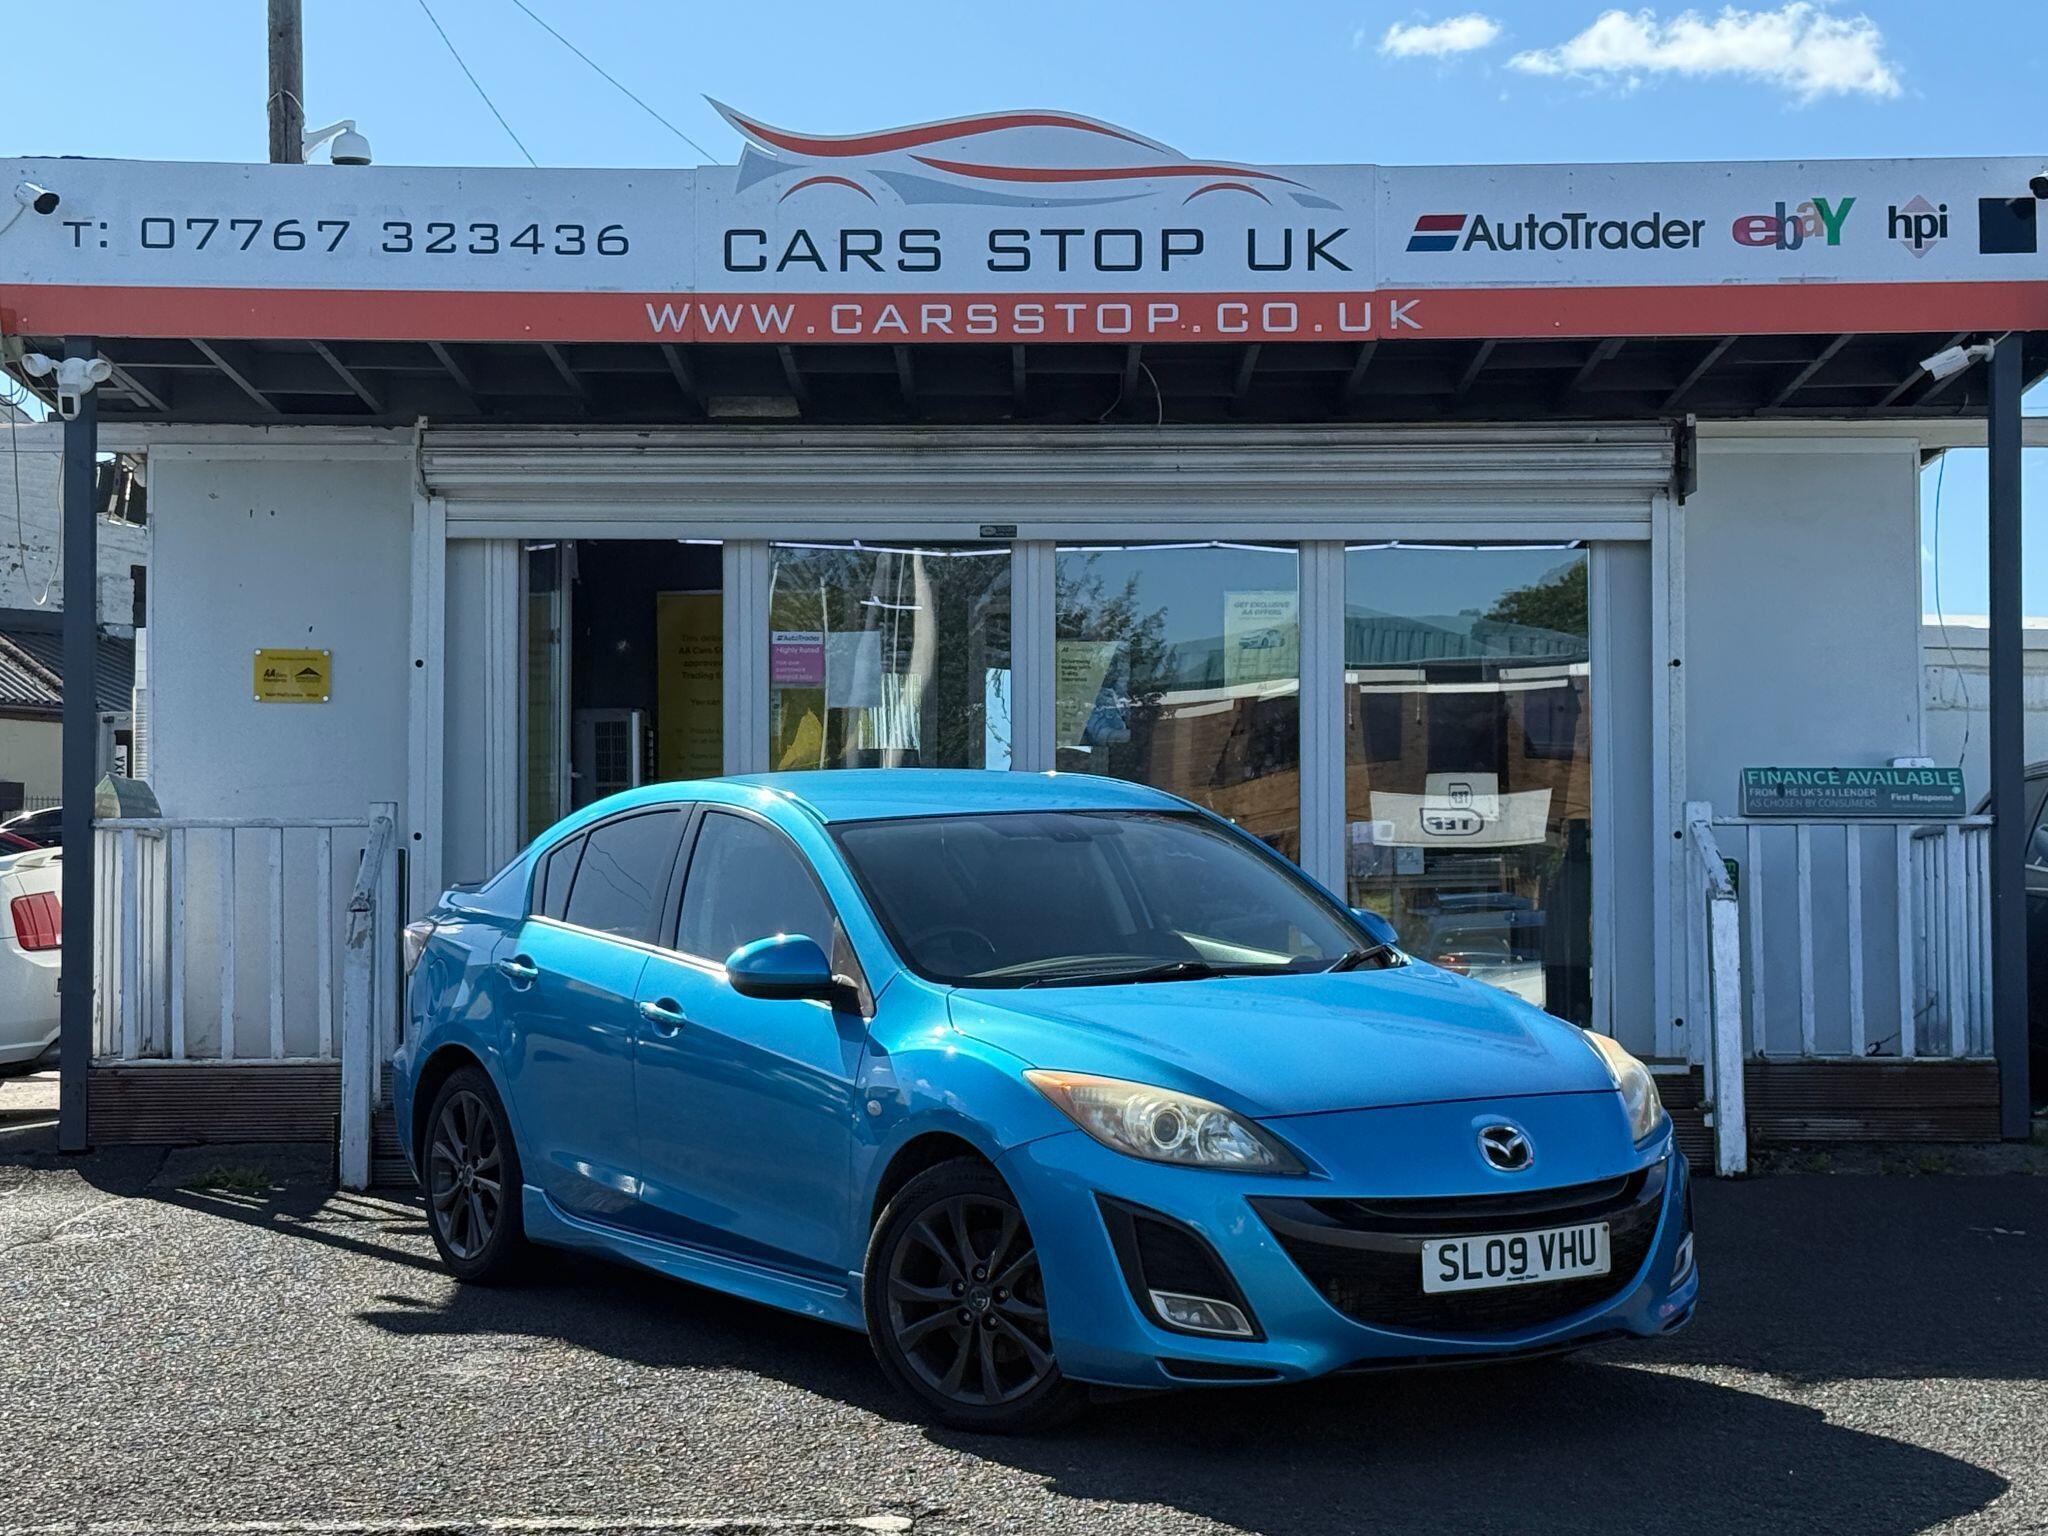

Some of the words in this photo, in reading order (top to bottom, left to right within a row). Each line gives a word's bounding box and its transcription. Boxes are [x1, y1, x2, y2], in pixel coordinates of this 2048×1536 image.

[62, 221, 108, 248] T:
[141, 217, 350, 252] 07767
[382, 221, 629, 256] 323436
[1461, 211, 1706, 252] AutoTrader
[1888, 203, 1948, 249] hpi
[724, 229, 942, 273] CARS
[986, 228, 1204, 272] STOP
[1247, 228, 1353, 272] UK
[645, 299, 1421, 334] WWW.CARSSTOP.CO.UK
[1747, 770, 1841, 785] FINANCE
[1845, 771, 1961, 786] AVAILABLE
[1749, 788, 1777, 797] FROM
[1778, 788, 1799, 797] HE
[1800, 788, 1825, 797] UK'S
[1838, 788, 1878, 797] LENDER
[1763, 799, 1803, 808] CHOSEN
[1805, 799, 1819, 808] BY
[1819, 799, 1878, 808] CONSUMERS
[1890, 793, 1911, 802] First
[1911, 793, 1955, 803] Response
[1438, 1236, 1528, 1283] SL09
[1537, 1227, 1598, 1272] VHU
